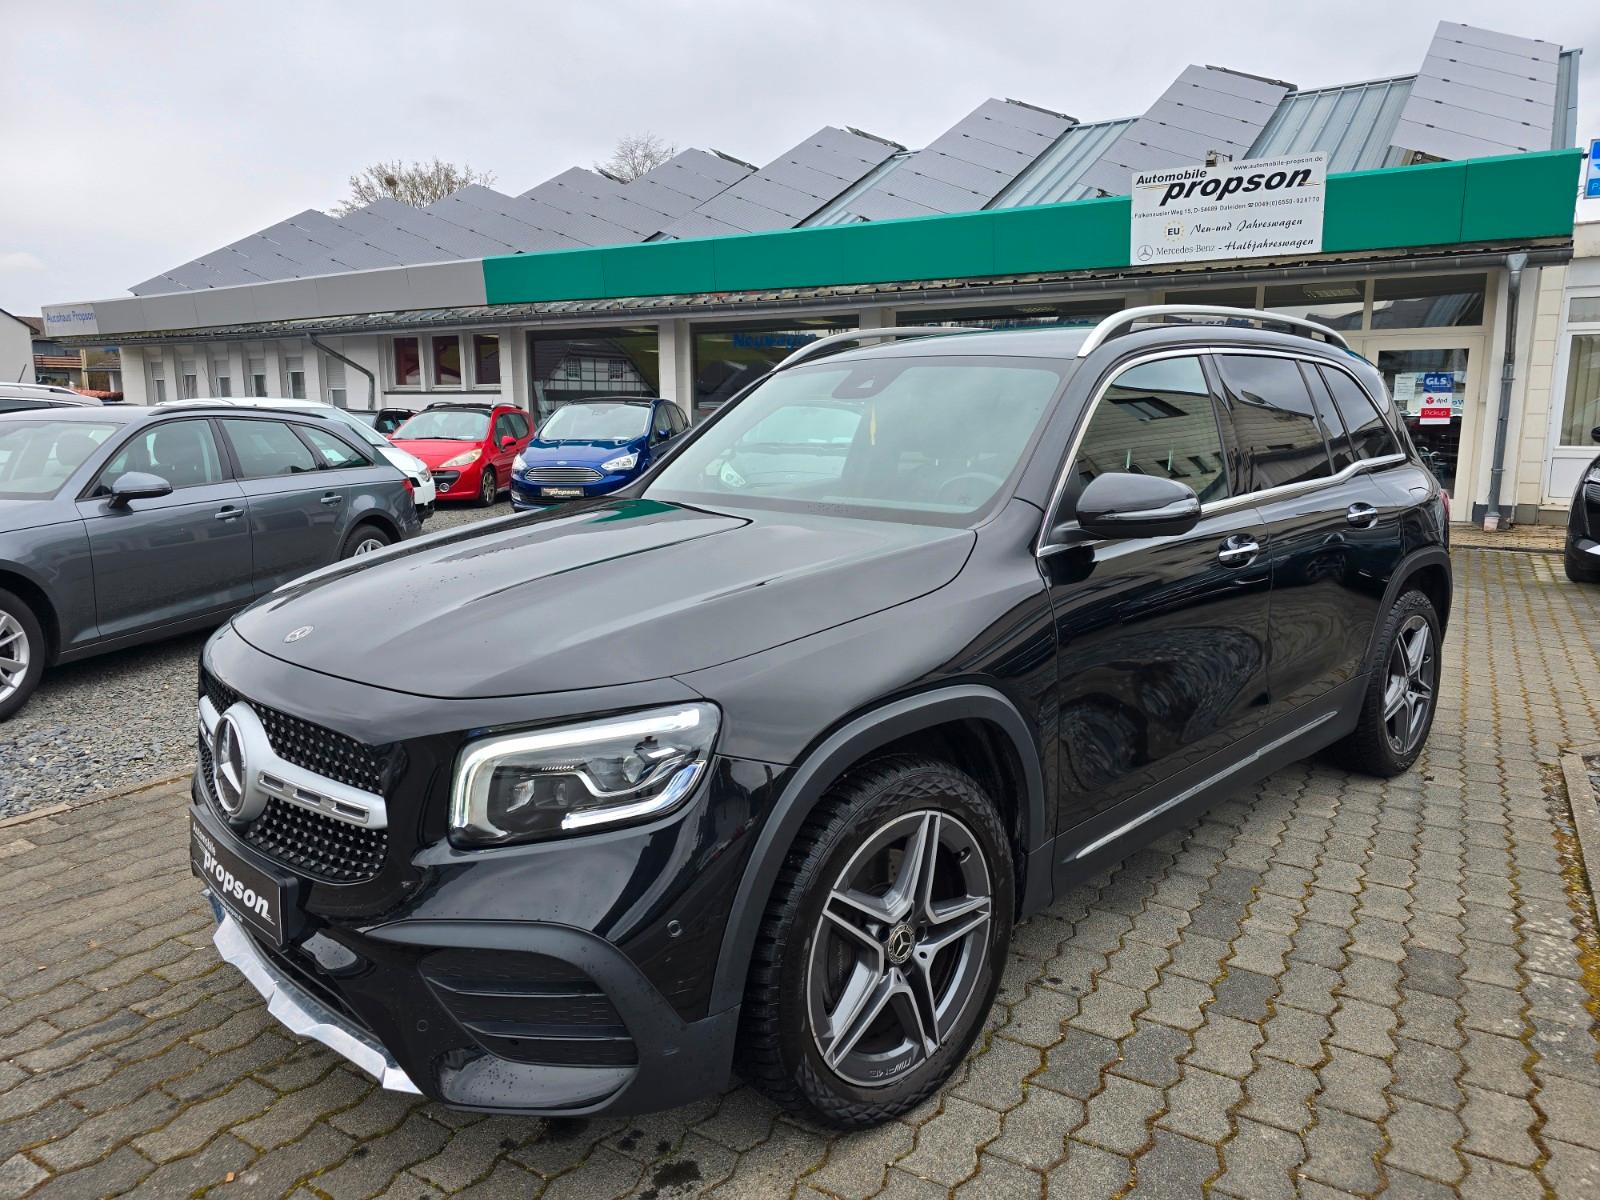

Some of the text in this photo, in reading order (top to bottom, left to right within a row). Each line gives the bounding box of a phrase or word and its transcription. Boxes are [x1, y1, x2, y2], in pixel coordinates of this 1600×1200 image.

[1136, 169, 1208, 185] Automobile
[1159, 168, 1312, 206] propson
[1167, 227, 1180, 236] EU
[1236, 218, 1303, 232] Jahreswagen
[1425, 377, 1447, 386] GLS
[203, 849, 271, 919] propson
